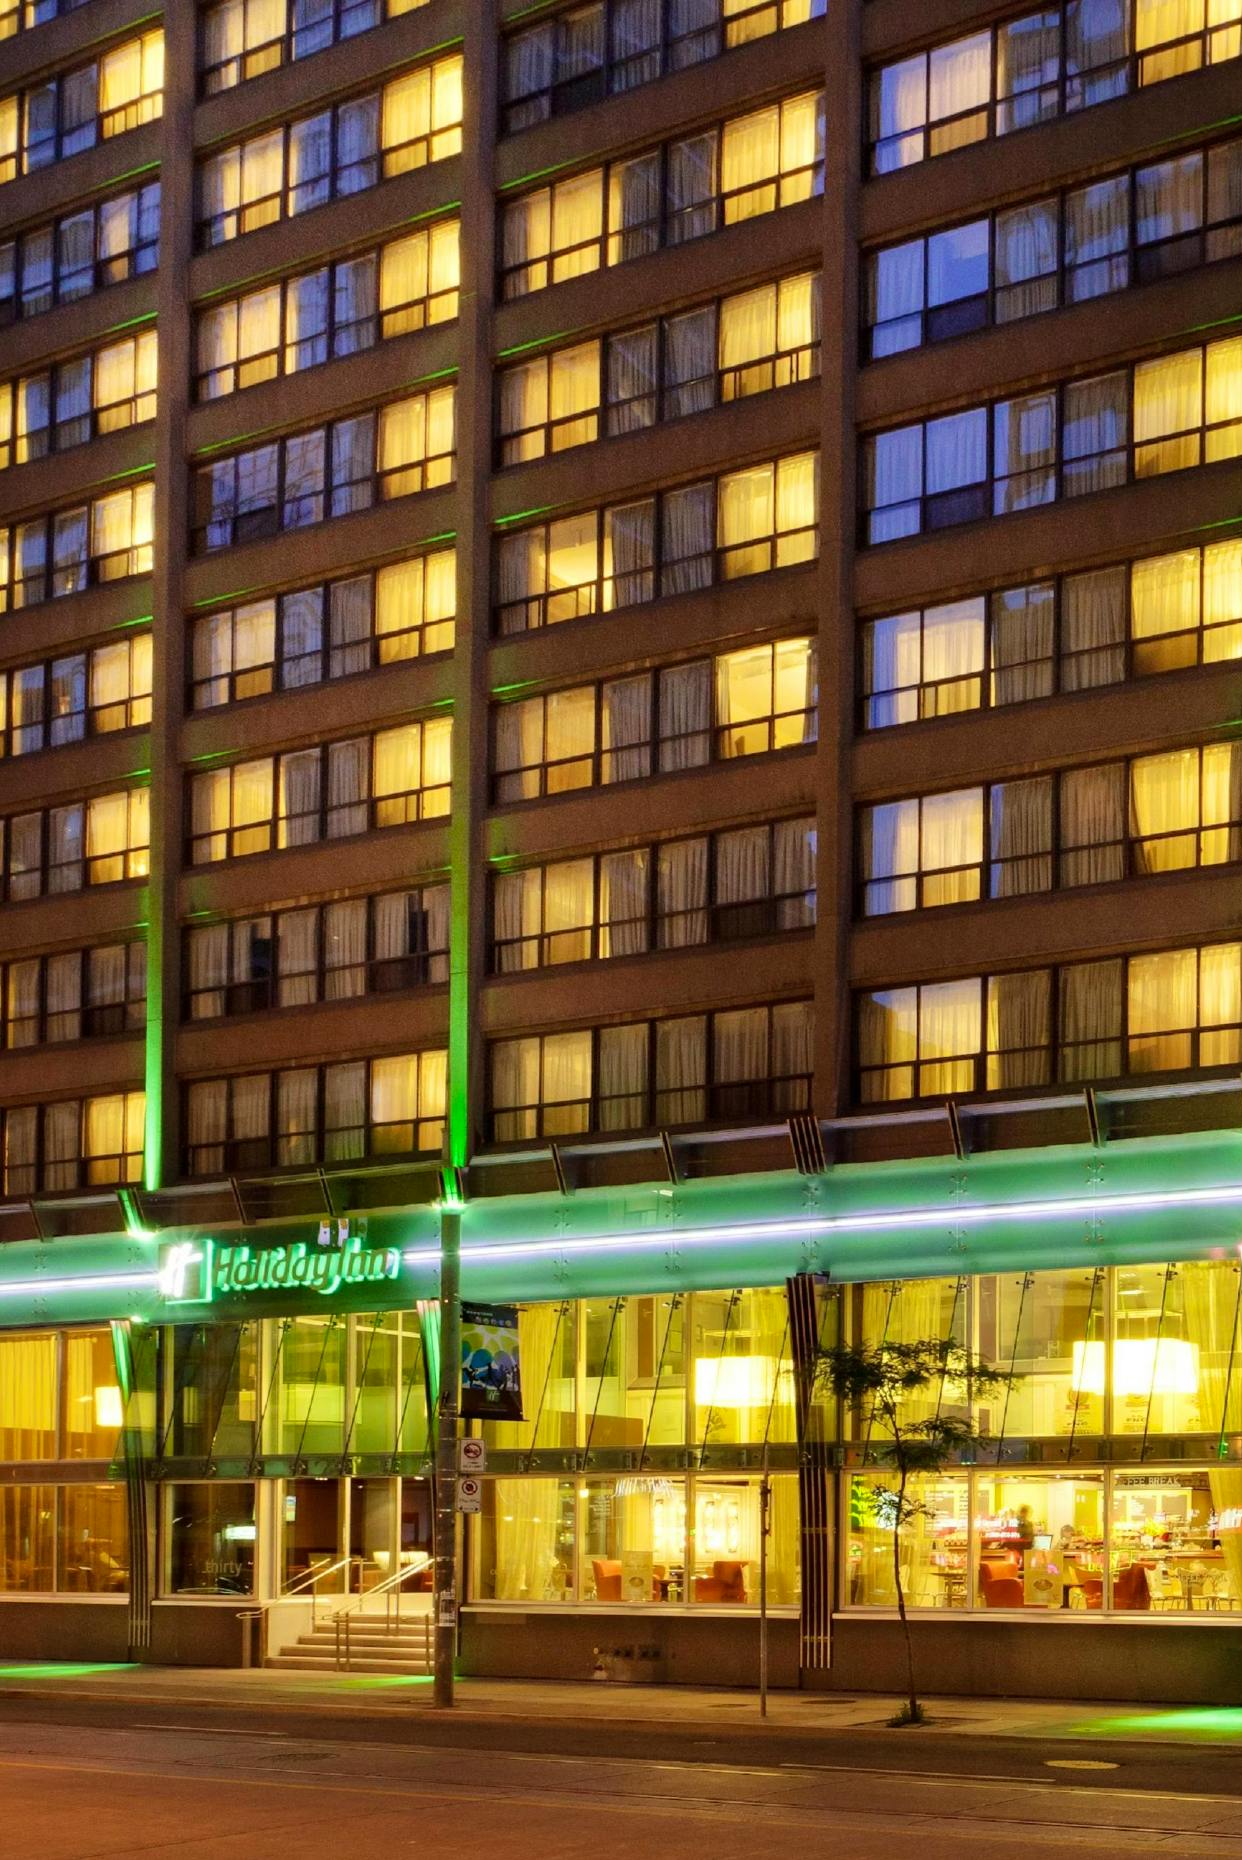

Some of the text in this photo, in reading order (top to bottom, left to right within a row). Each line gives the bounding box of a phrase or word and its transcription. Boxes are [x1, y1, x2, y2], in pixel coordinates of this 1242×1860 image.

[213, 1242, 341, 1296] Holiday
[337, 1236, 401, 1284] Inn
[1148, 1475, 1181, 1487] BREAK
[205, 1560, 243, 1578] thirty
